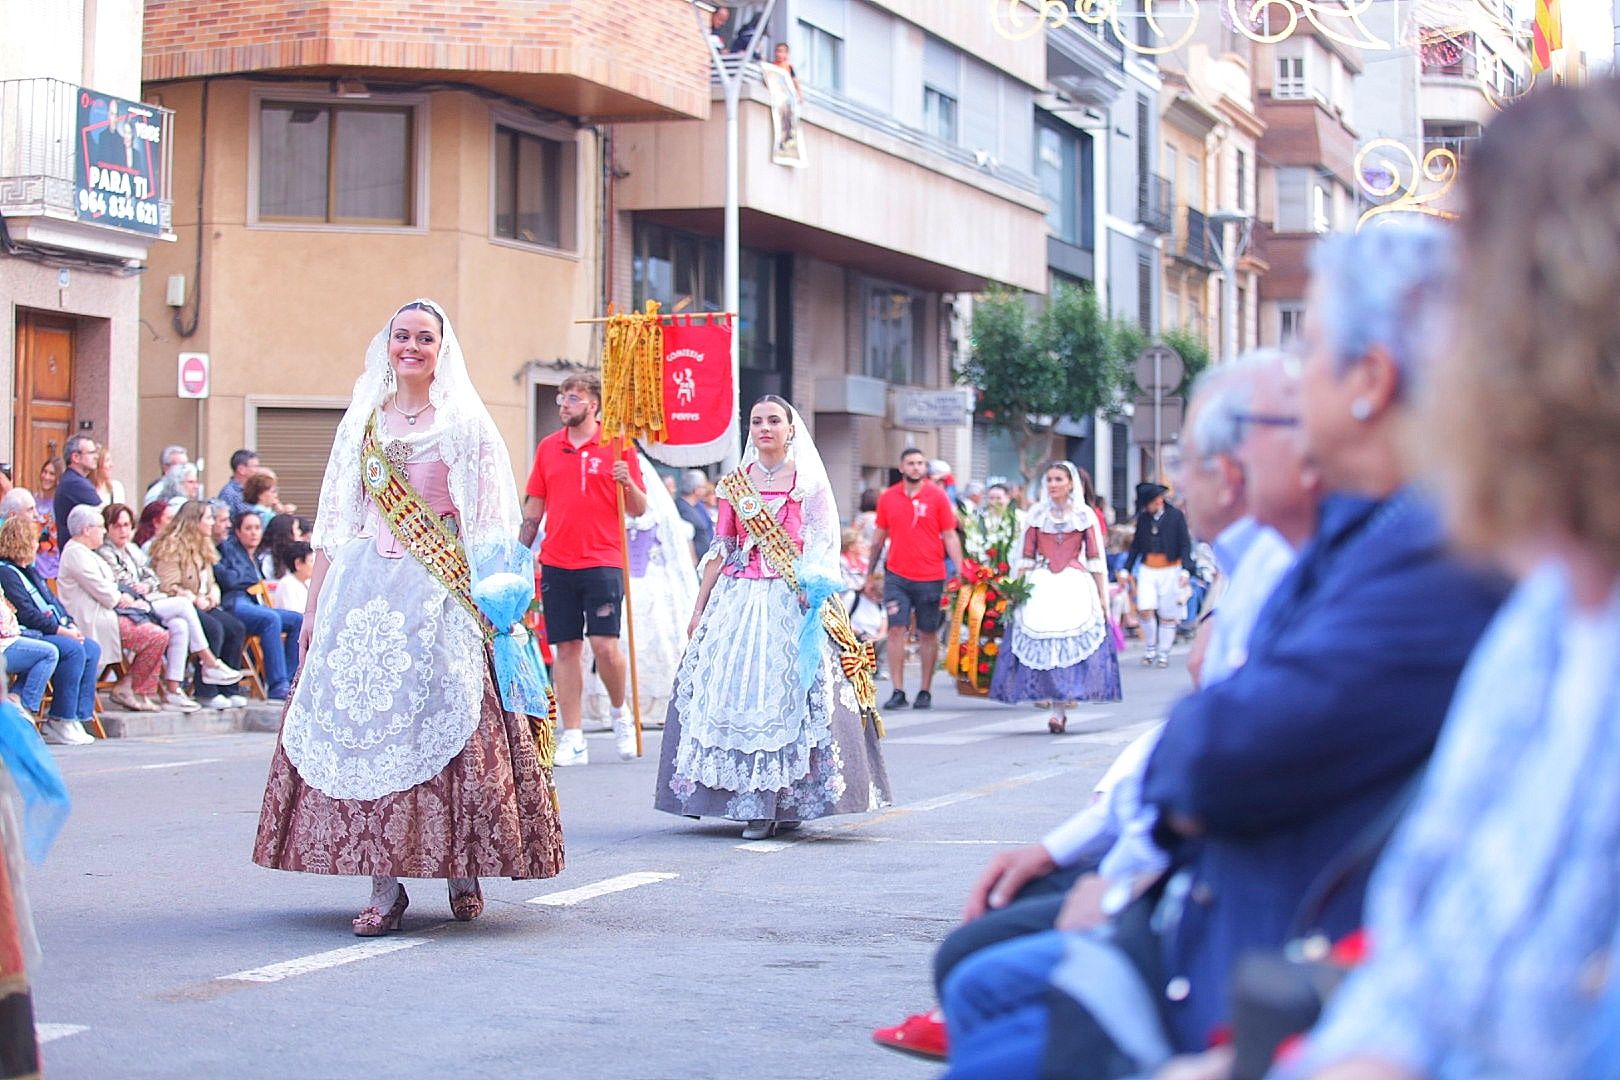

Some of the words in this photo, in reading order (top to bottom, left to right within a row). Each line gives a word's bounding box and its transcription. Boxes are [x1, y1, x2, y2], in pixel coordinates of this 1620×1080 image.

[89, 166, 132, 197] PARA
[134, 175, 148, 200] TI
[79, 189, 107, 215] 964
[109, 194, 135, 220] 834
[136, 200, 158, 225] 621
